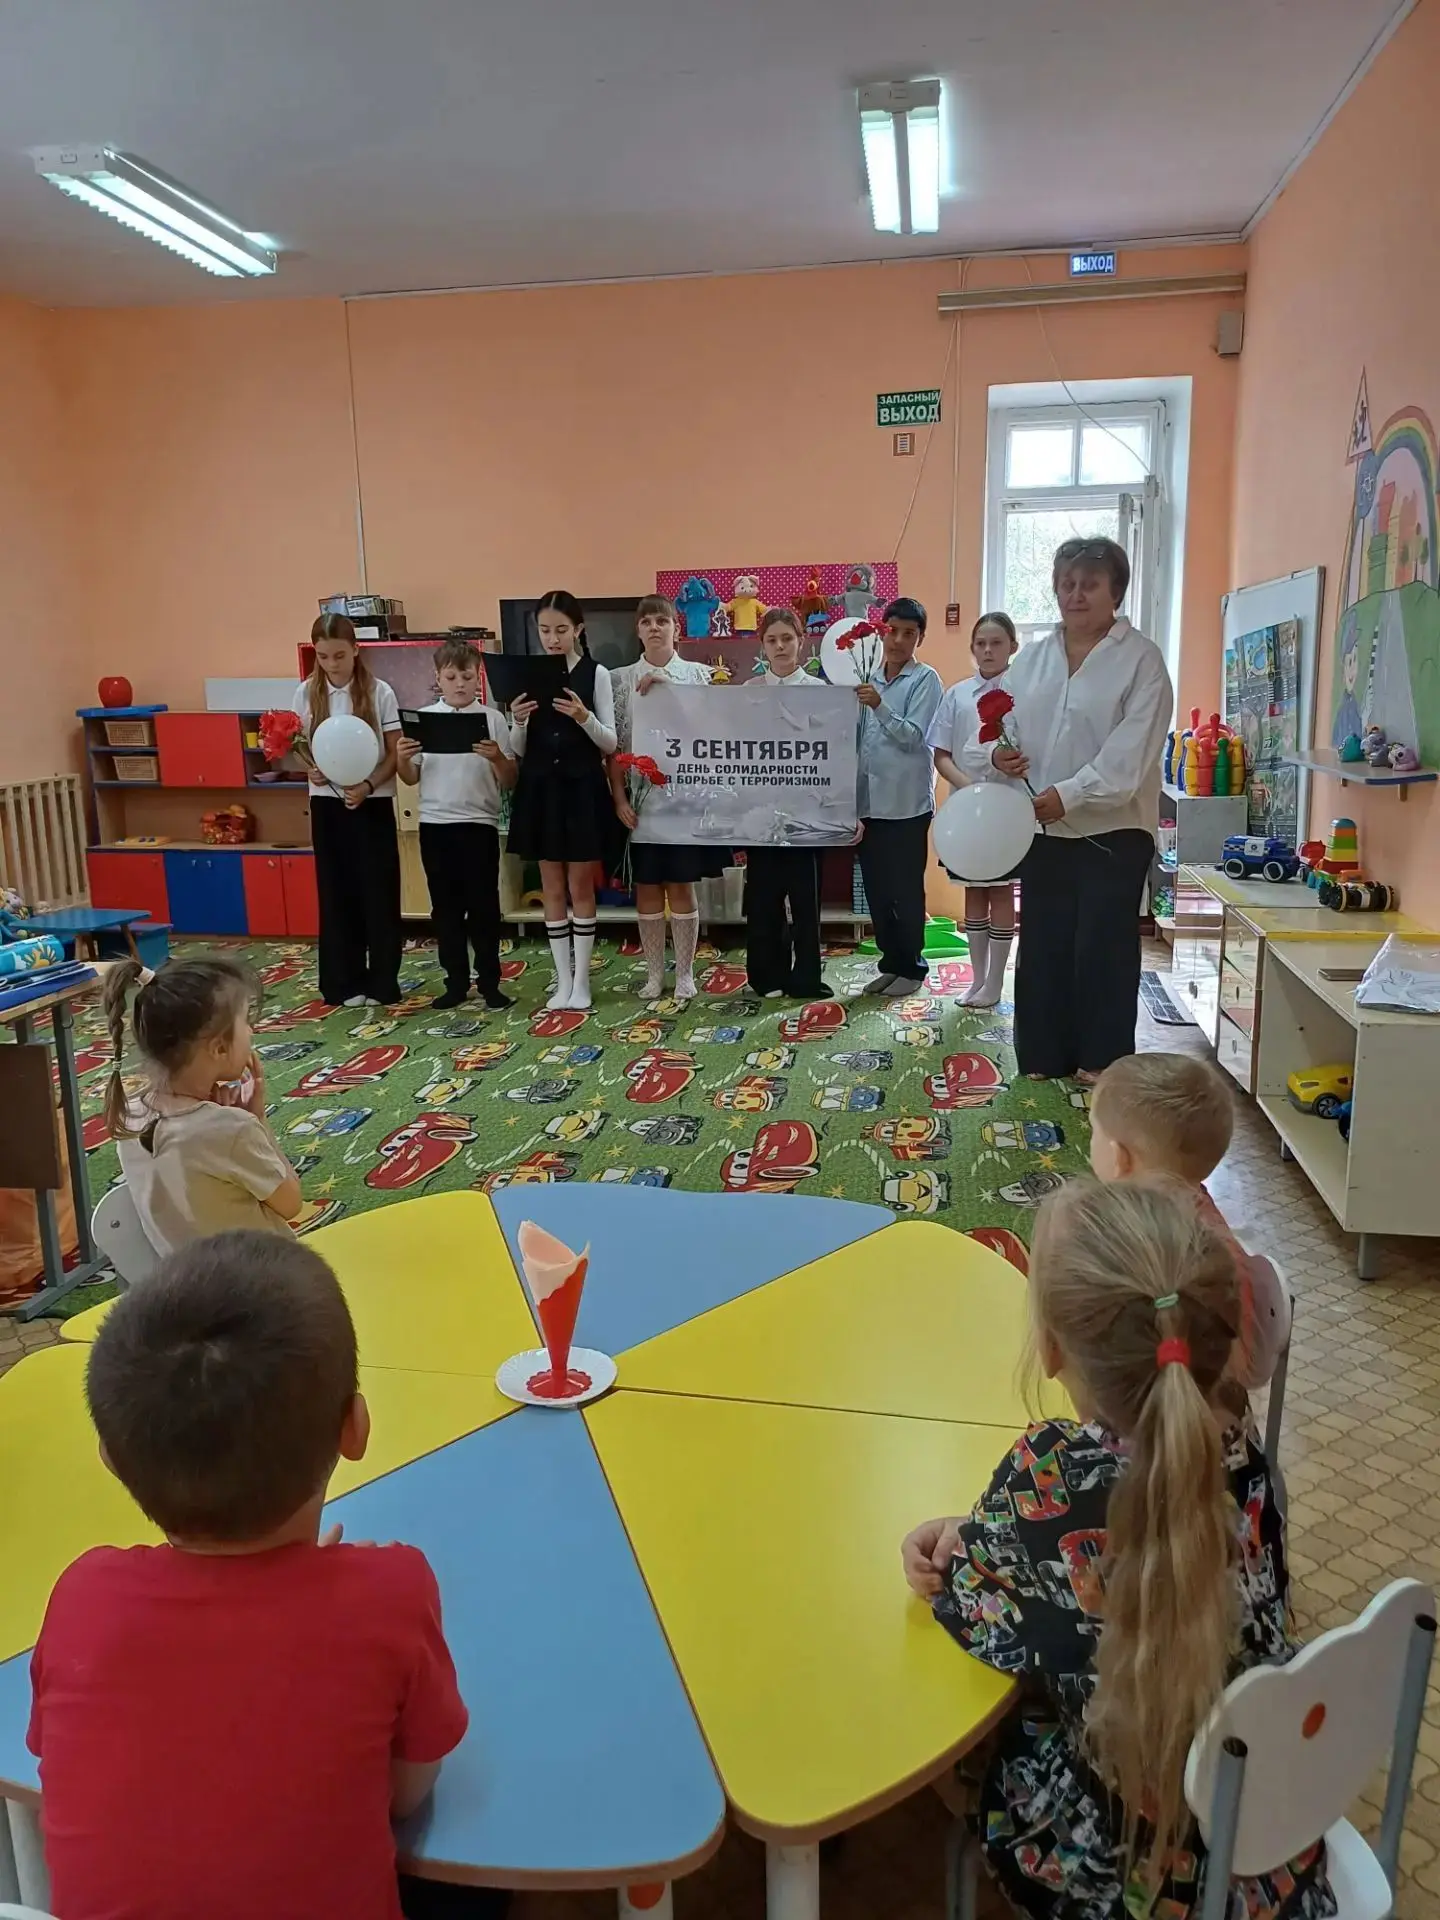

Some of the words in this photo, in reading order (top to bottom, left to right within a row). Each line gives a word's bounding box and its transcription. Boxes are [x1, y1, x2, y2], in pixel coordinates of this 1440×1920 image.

[1073, 255, 1114, 273] ВЫХОД
[880, 390, 939, 405] ЗАПАСНЫЙ
[880, 404, 940, 423] ВЫХОД
[665, 738, 682, 759] 3
[692, 740, 828, 761] СЕНТЯБРЯ
[676, 763, 710, 774] ДЕНЬ
[715, 764, 818, 775] СОЛИДАРНОСТИ
[676, 775, 724, 785] БОРЬБЕ
[728, 776, 736, 786] С
[740, 776, 831, 787] ТЕРРОРИЗМОМ
